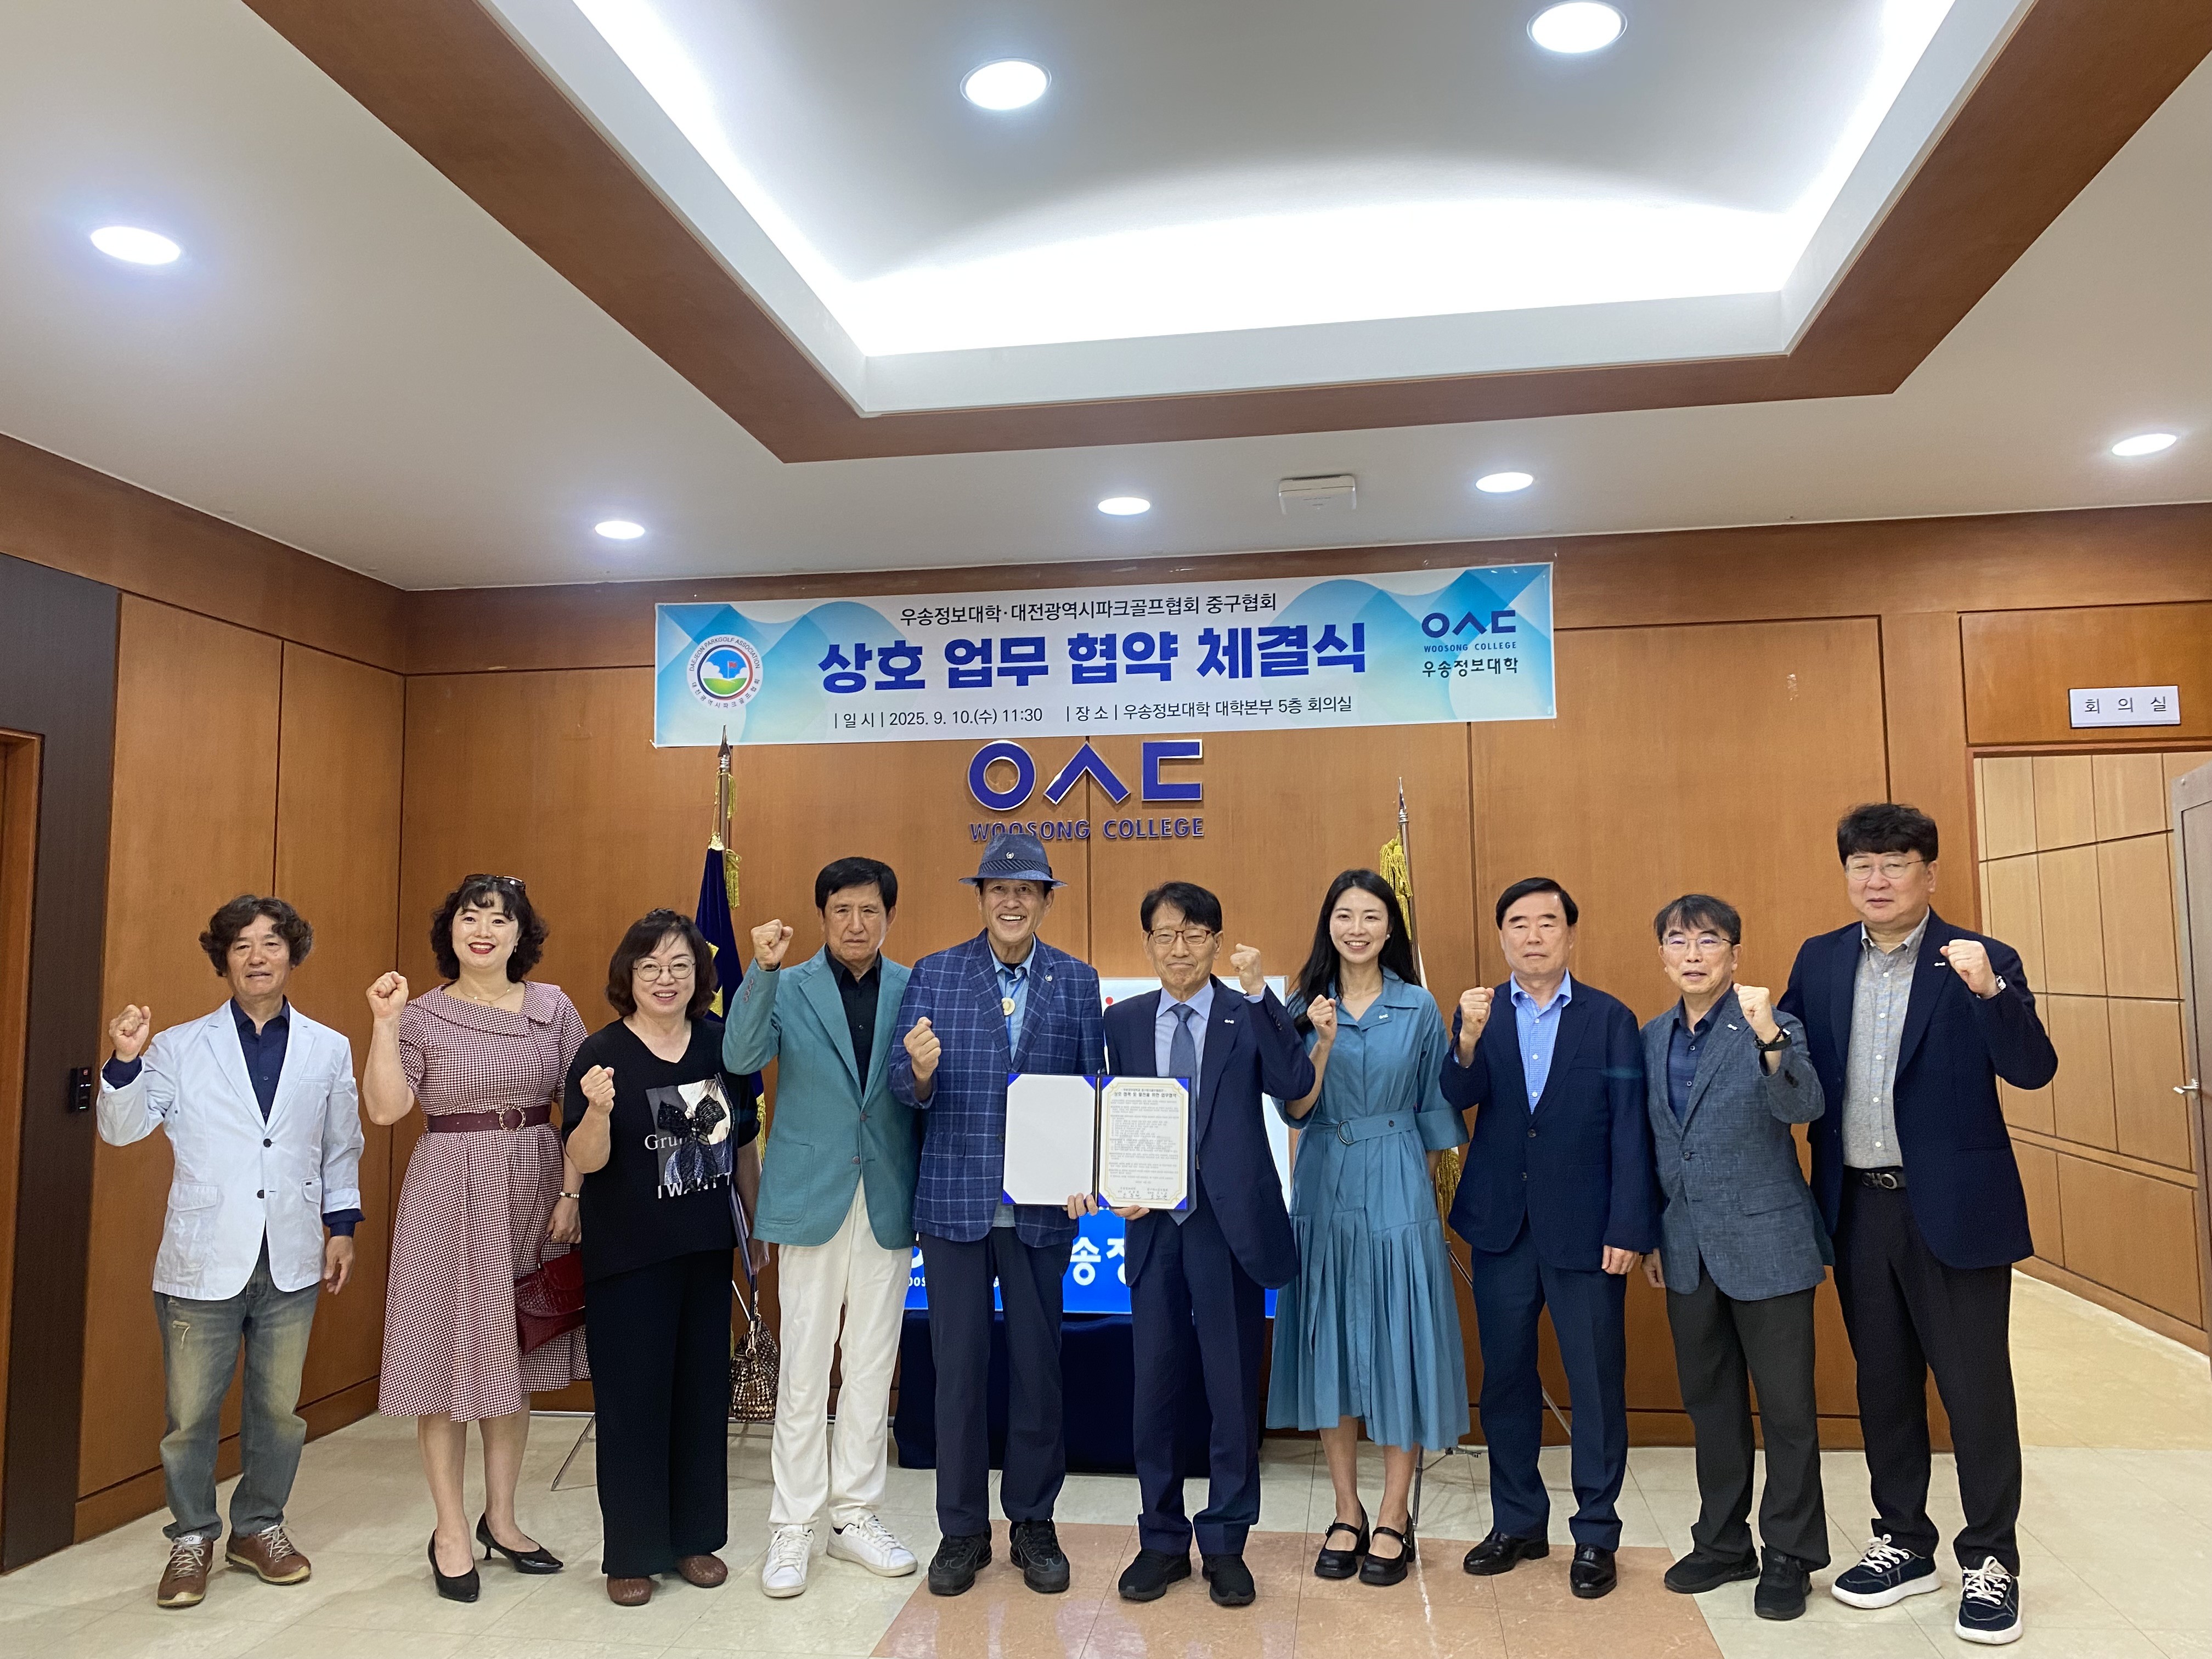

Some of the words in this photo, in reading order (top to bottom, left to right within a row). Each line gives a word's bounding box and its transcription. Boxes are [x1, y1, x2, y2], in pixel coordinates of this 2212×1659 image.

[1206, 592, 1276, 614] 중구협회
[689, 645, 706, 672] DAEJEON
[704, 636, 735, 648] PARKGOLF
[735, 639, 760, 669] ASSOCIATION
[817, 640, 926, 694] 상호
[944, 636, 1049, 689] 업무
[1067, 631, 1178, 685] 협약
[1196, 622, 1365, 679] 체결식
[1424, 644, 1468, 653] WOOSONG
[1475, 641, 1516, 650] COLLEGE
[1422, 657, 1519, 679] 우송정보대학
[889, 712, 928, 726] 2025.
[934, 711, 946, 725] 9.
[952, 708, 997, 725] 10.(수)
[1002, 708, 1043, 723] 11:30
[1123, 701, 1211, 720] 우송정보대학
[1216, 699, 1274, 716] 대학본부
[1278, 697, 1303, 714] 5층
[1307, 695, 1352, 713] 회의실
[970, 819, 1091, 842] WOOSONG
[1103, 816, 1205, 839] COLLEGE
